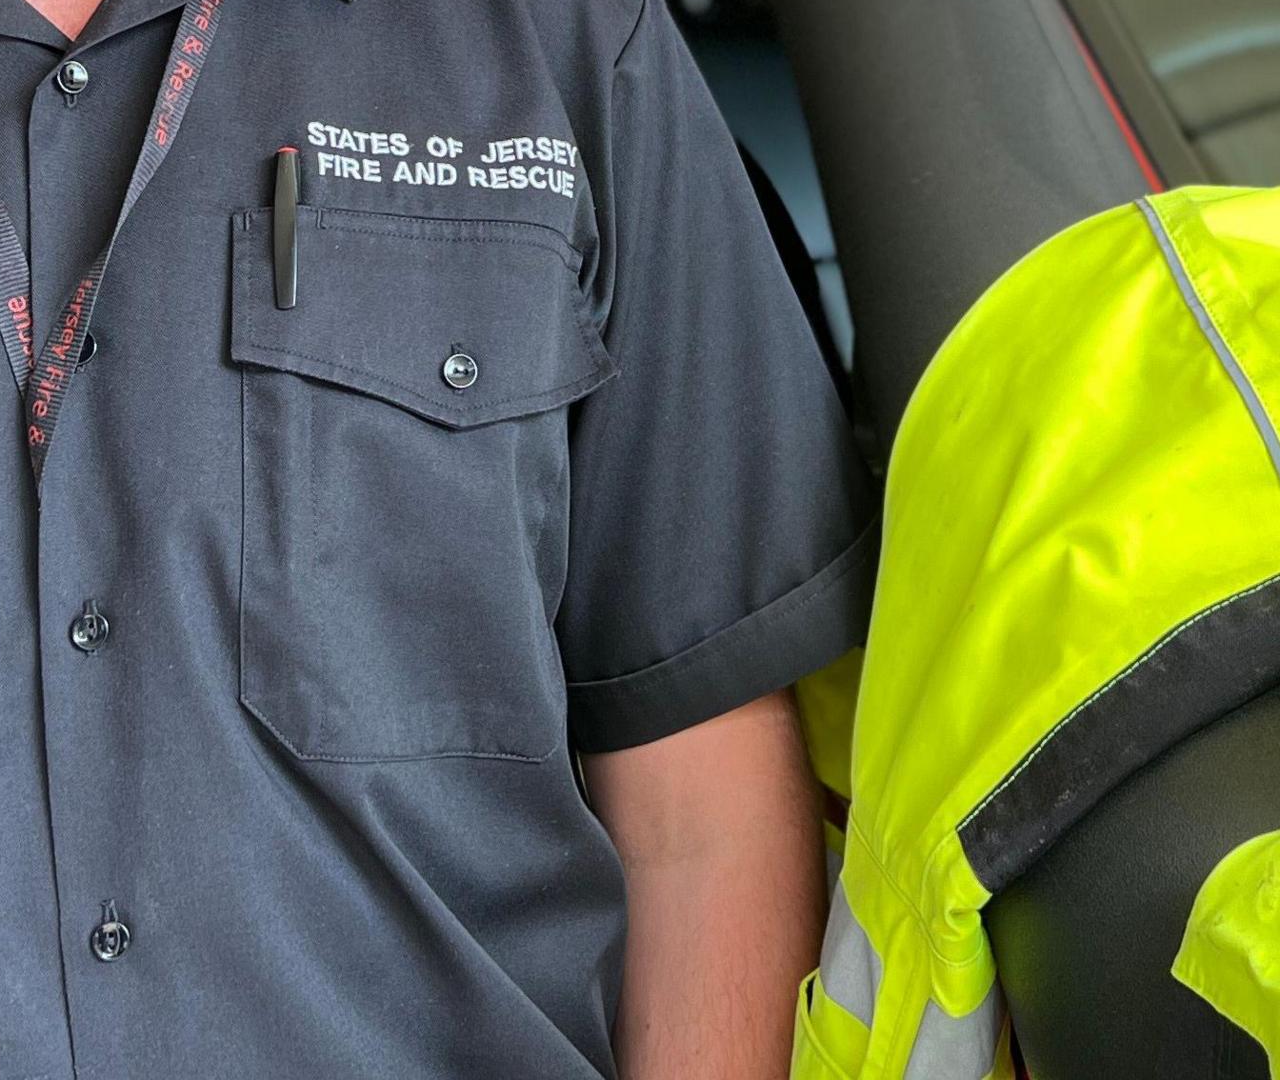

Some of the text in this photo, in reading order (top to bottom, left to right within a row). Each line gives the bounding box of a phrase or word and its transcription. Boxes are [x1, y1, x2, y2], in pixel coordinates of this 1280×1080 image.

[180, 35, 204, 56] &
[154, 59, 194, 147] Rescue
[307, 121, 578, 168] STATES OF JERSEY
[317, 151, 576, 199] FIRE AND RESCUE
[32, 366, 66, 417] Fire
[27, 424, 46, 447] &
